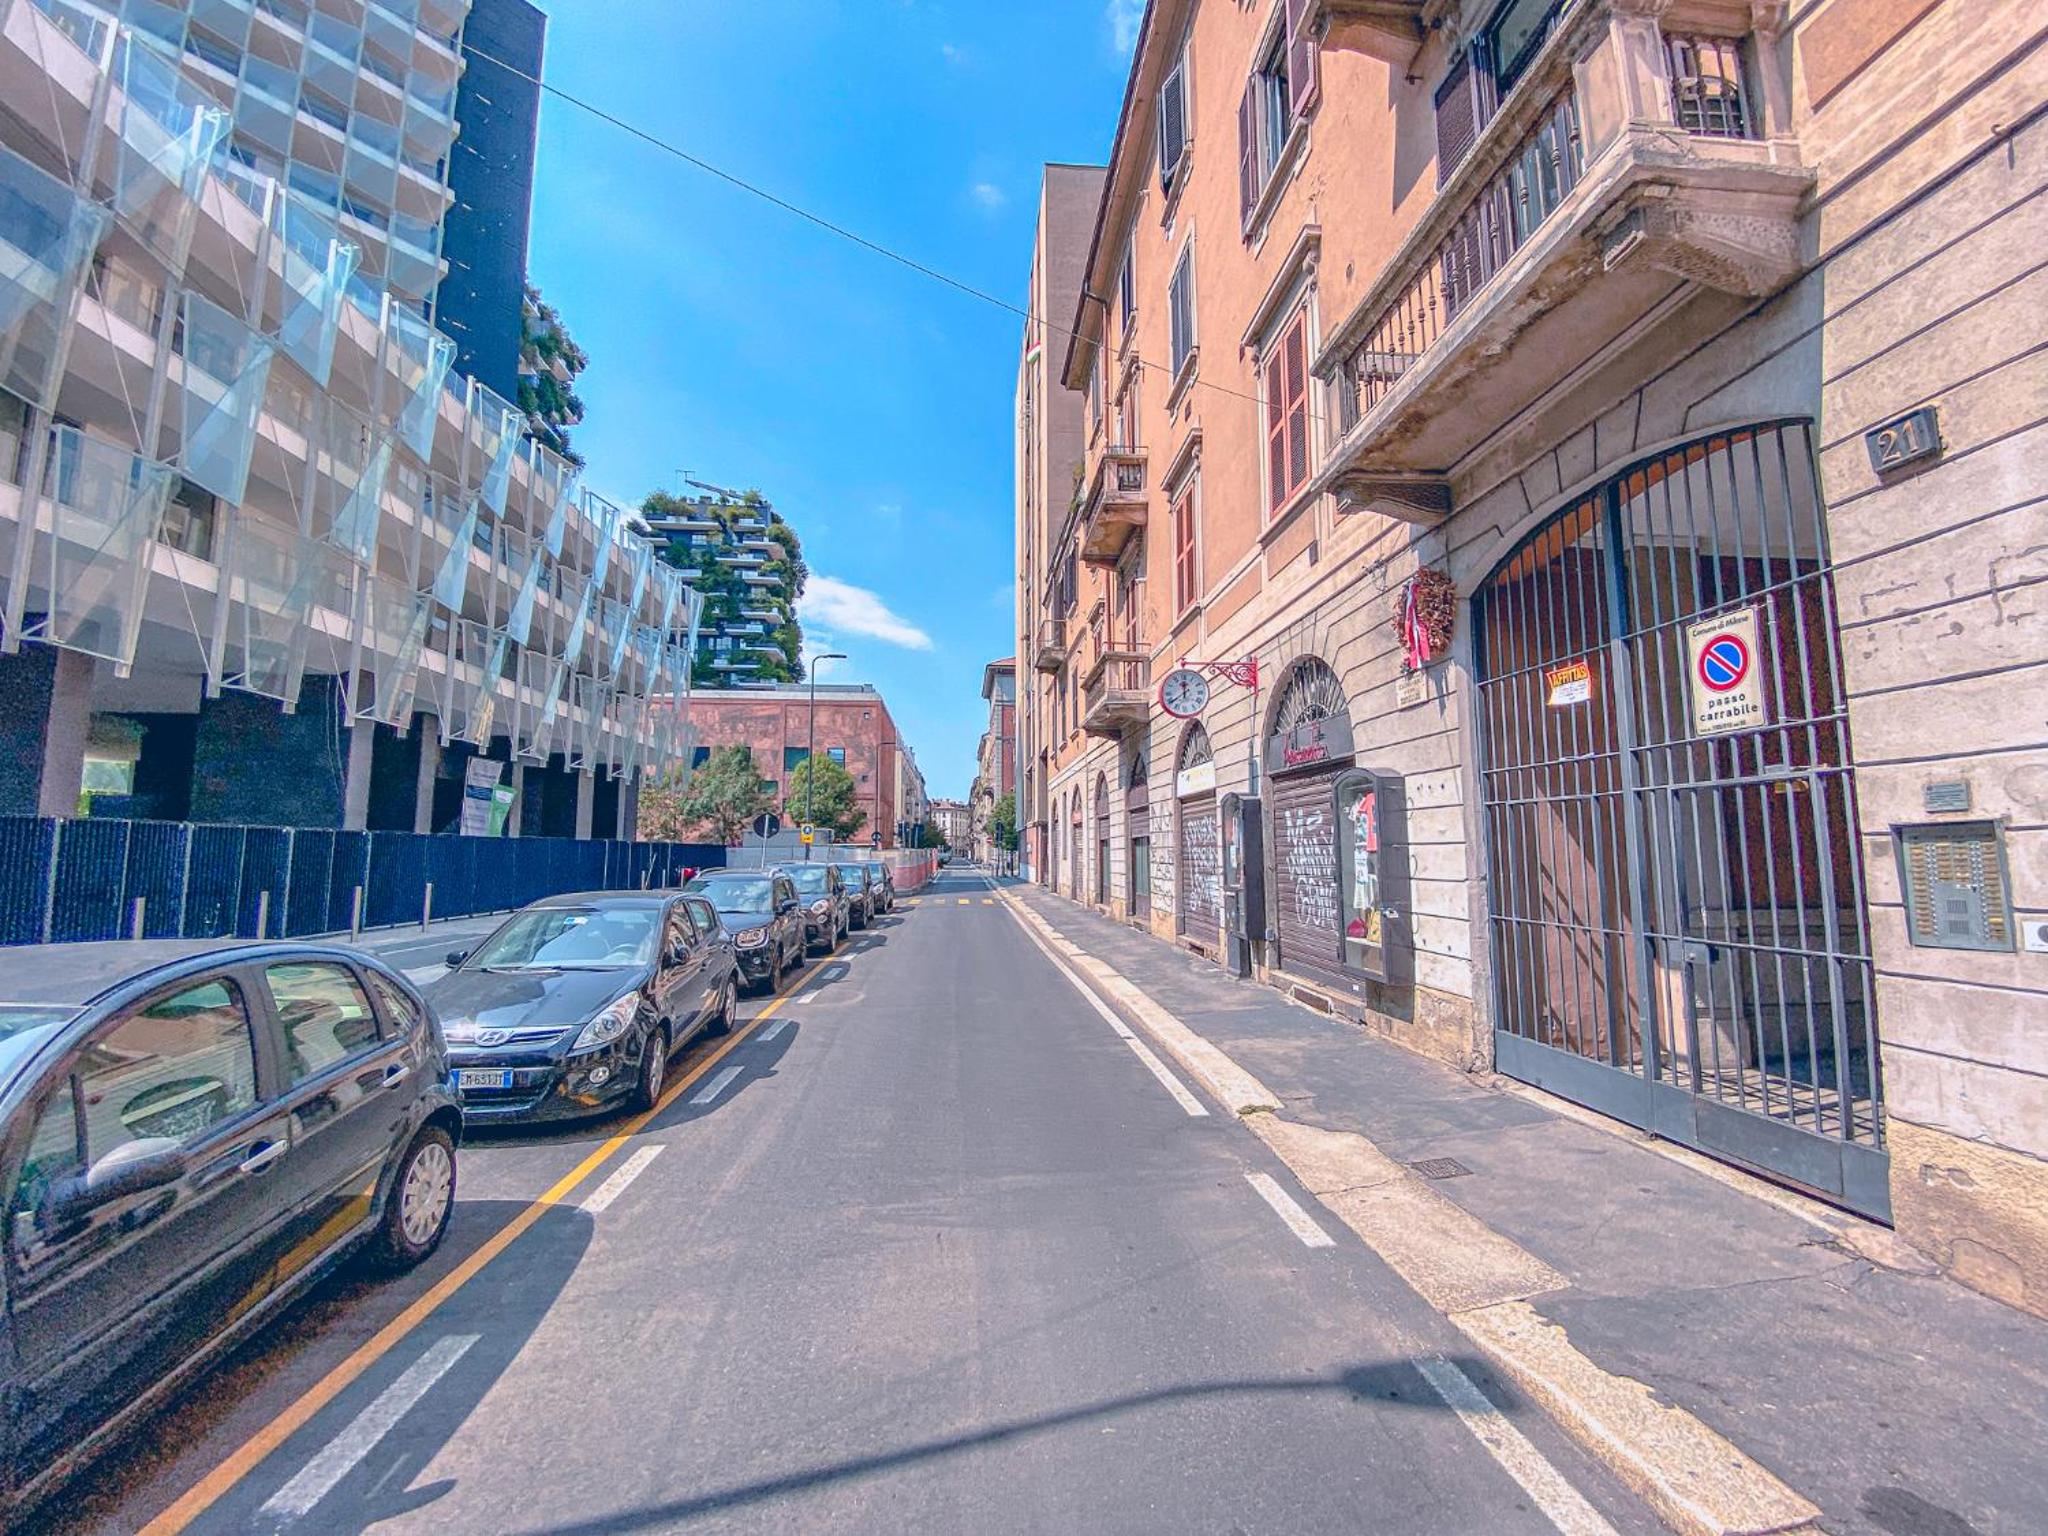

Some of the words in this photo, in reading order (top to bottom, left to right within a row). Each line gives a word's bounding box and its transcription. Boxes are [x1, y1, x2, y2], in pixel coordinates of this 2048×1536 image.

[1878, 419, 1919, 462] 21
[1708, 693, 1746, 709] passo
[1700, 703, 1759, 722] carrabile
